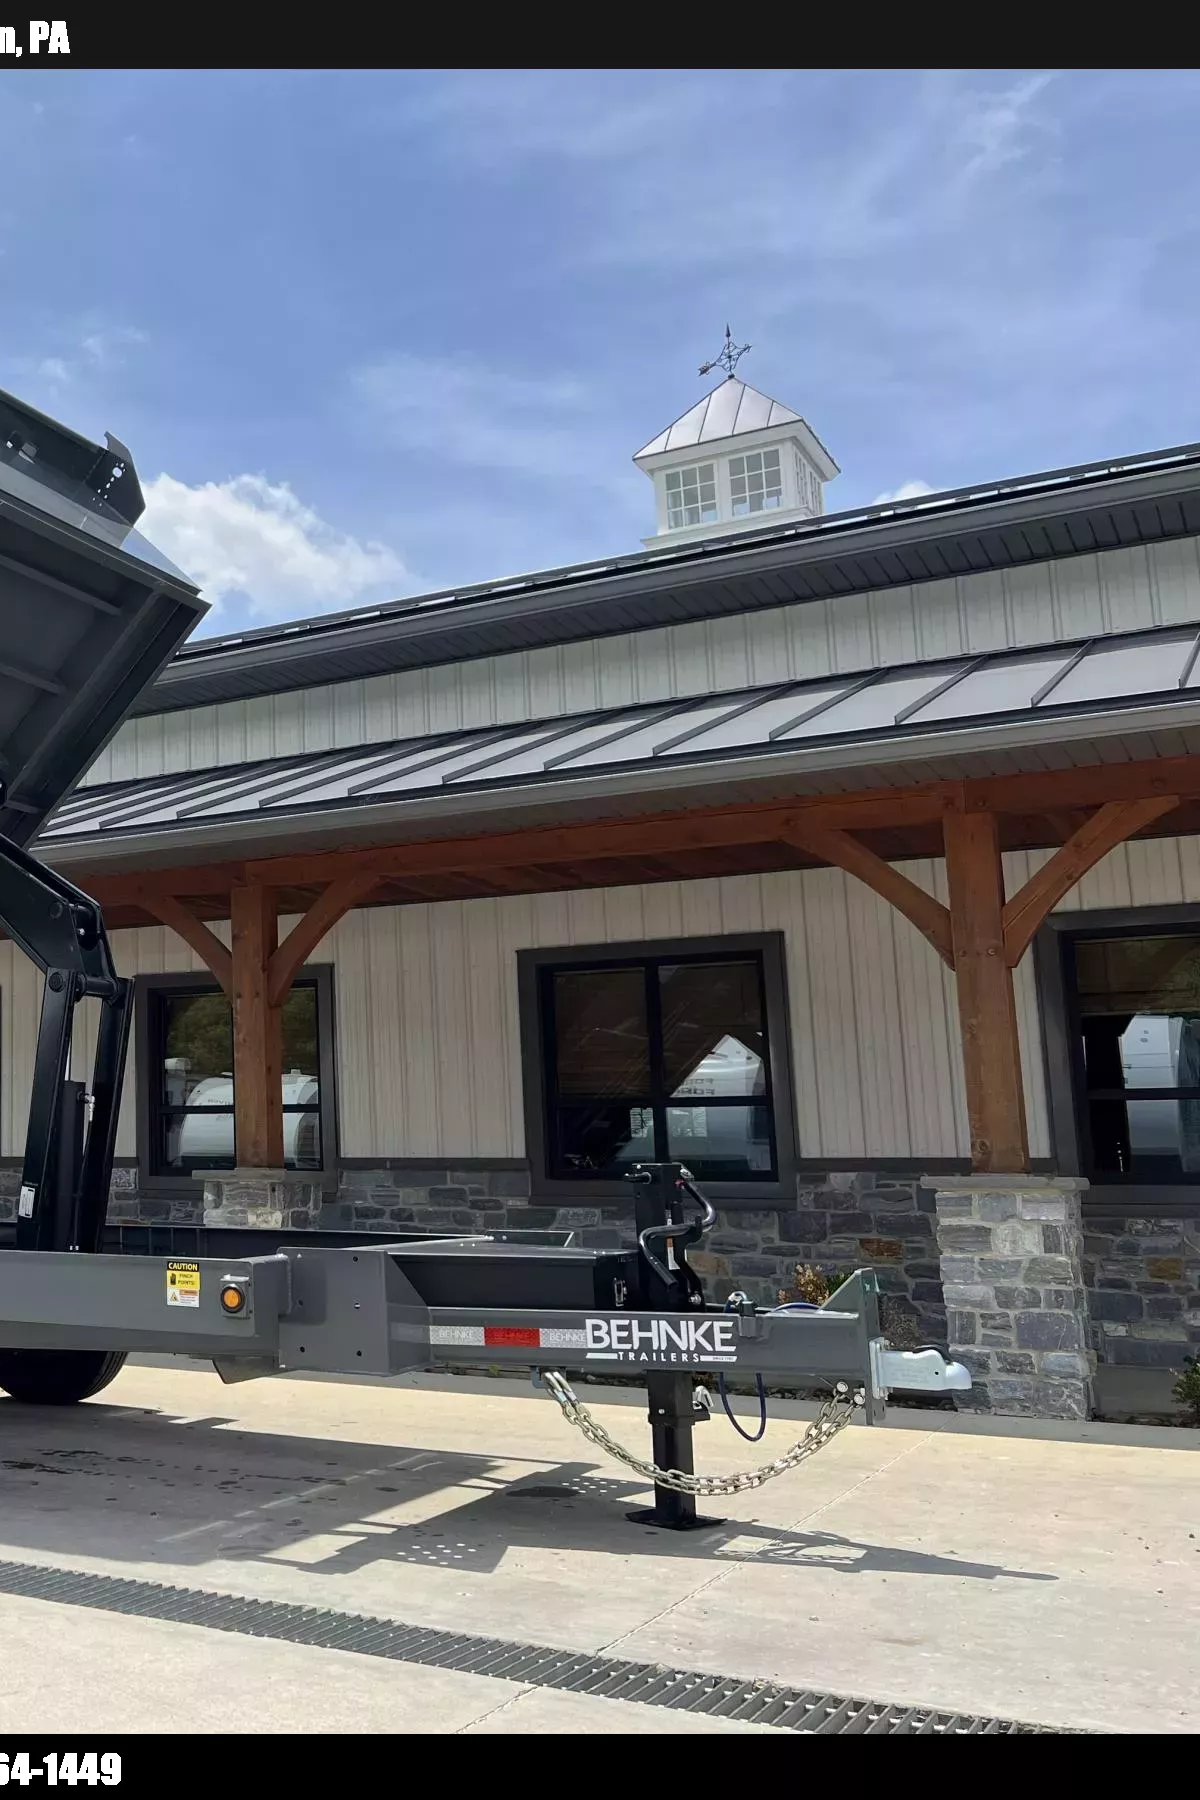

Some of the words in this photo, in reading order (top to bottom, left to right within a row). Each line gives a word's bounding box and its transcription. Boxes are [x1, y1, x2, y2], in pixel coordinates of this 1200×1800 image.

[168, 1262, 198, 1271] CAUTION
[438, 1329, 474, 1339] BEHNKE
[550, 1333, 587, 1343] BEHNKE
[585, 1319, 737, 1352] BEHNKE
[618, 1351, 699, 1362] TRAILERS
